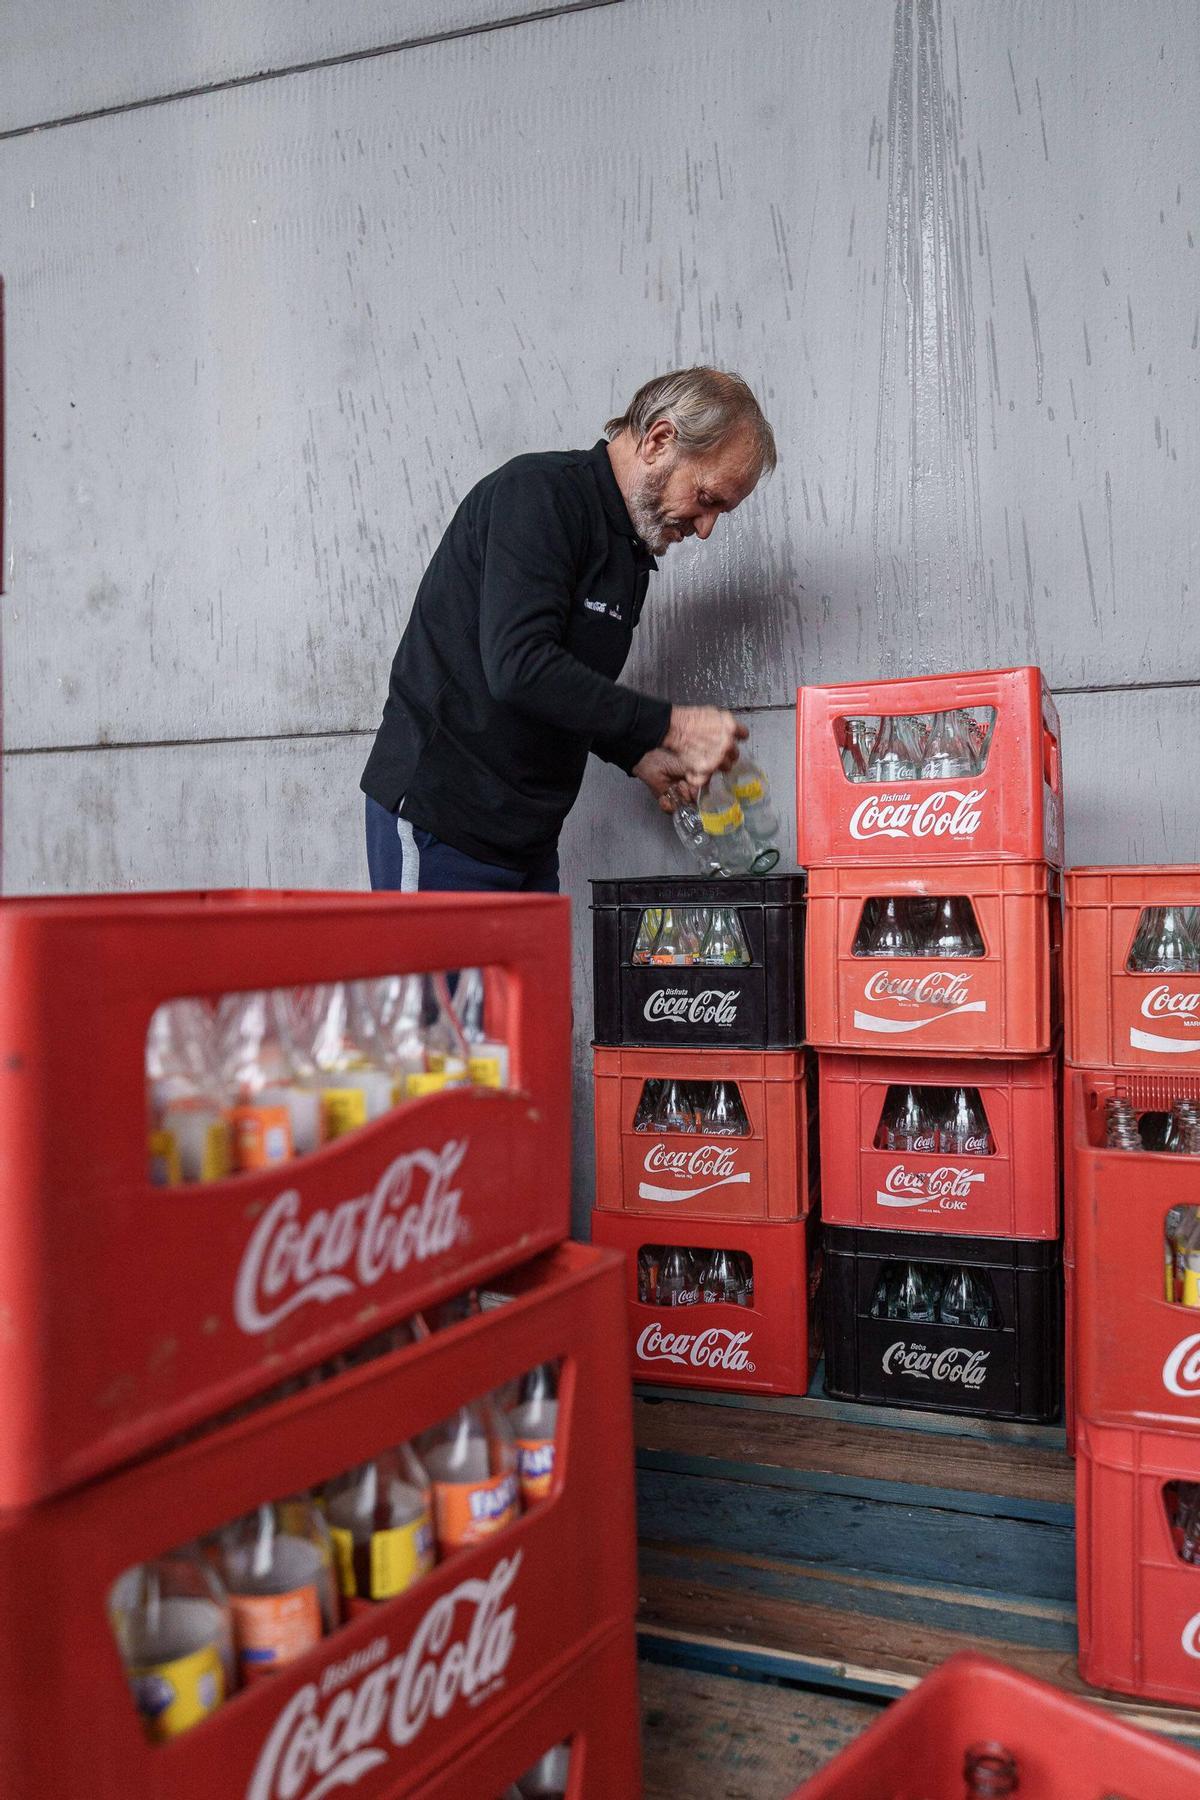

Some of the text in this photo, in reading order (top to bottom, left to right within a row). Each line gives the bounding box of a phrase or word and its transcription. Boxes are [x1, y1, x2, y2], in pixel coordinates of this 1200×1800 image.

[849, 788, 987, 840] Coca-Cola
[880, 793, 911, 802] Disfruta
[665, 988, 688, 996] Disfruta
[864, 970, 974, 1004] Coca-Cola
[643, 989, 740, 1023] Coca-Cola
[644, 1143, 738, 1176] Coca-Cola
[885, 1164, 974, 1197] Coca-Cola
[940, 1197, 967, 1210] Coke
[233, 1136, 469, 1334] Coca-Cola
[636, 1322, 753, 1371] Coca-Cola
[882, 1341, 990, 1385] Coca-Cola
[911, 1342, 926, 1351] Beba
[243, 1547, 523, 1800] Coca-Cola
